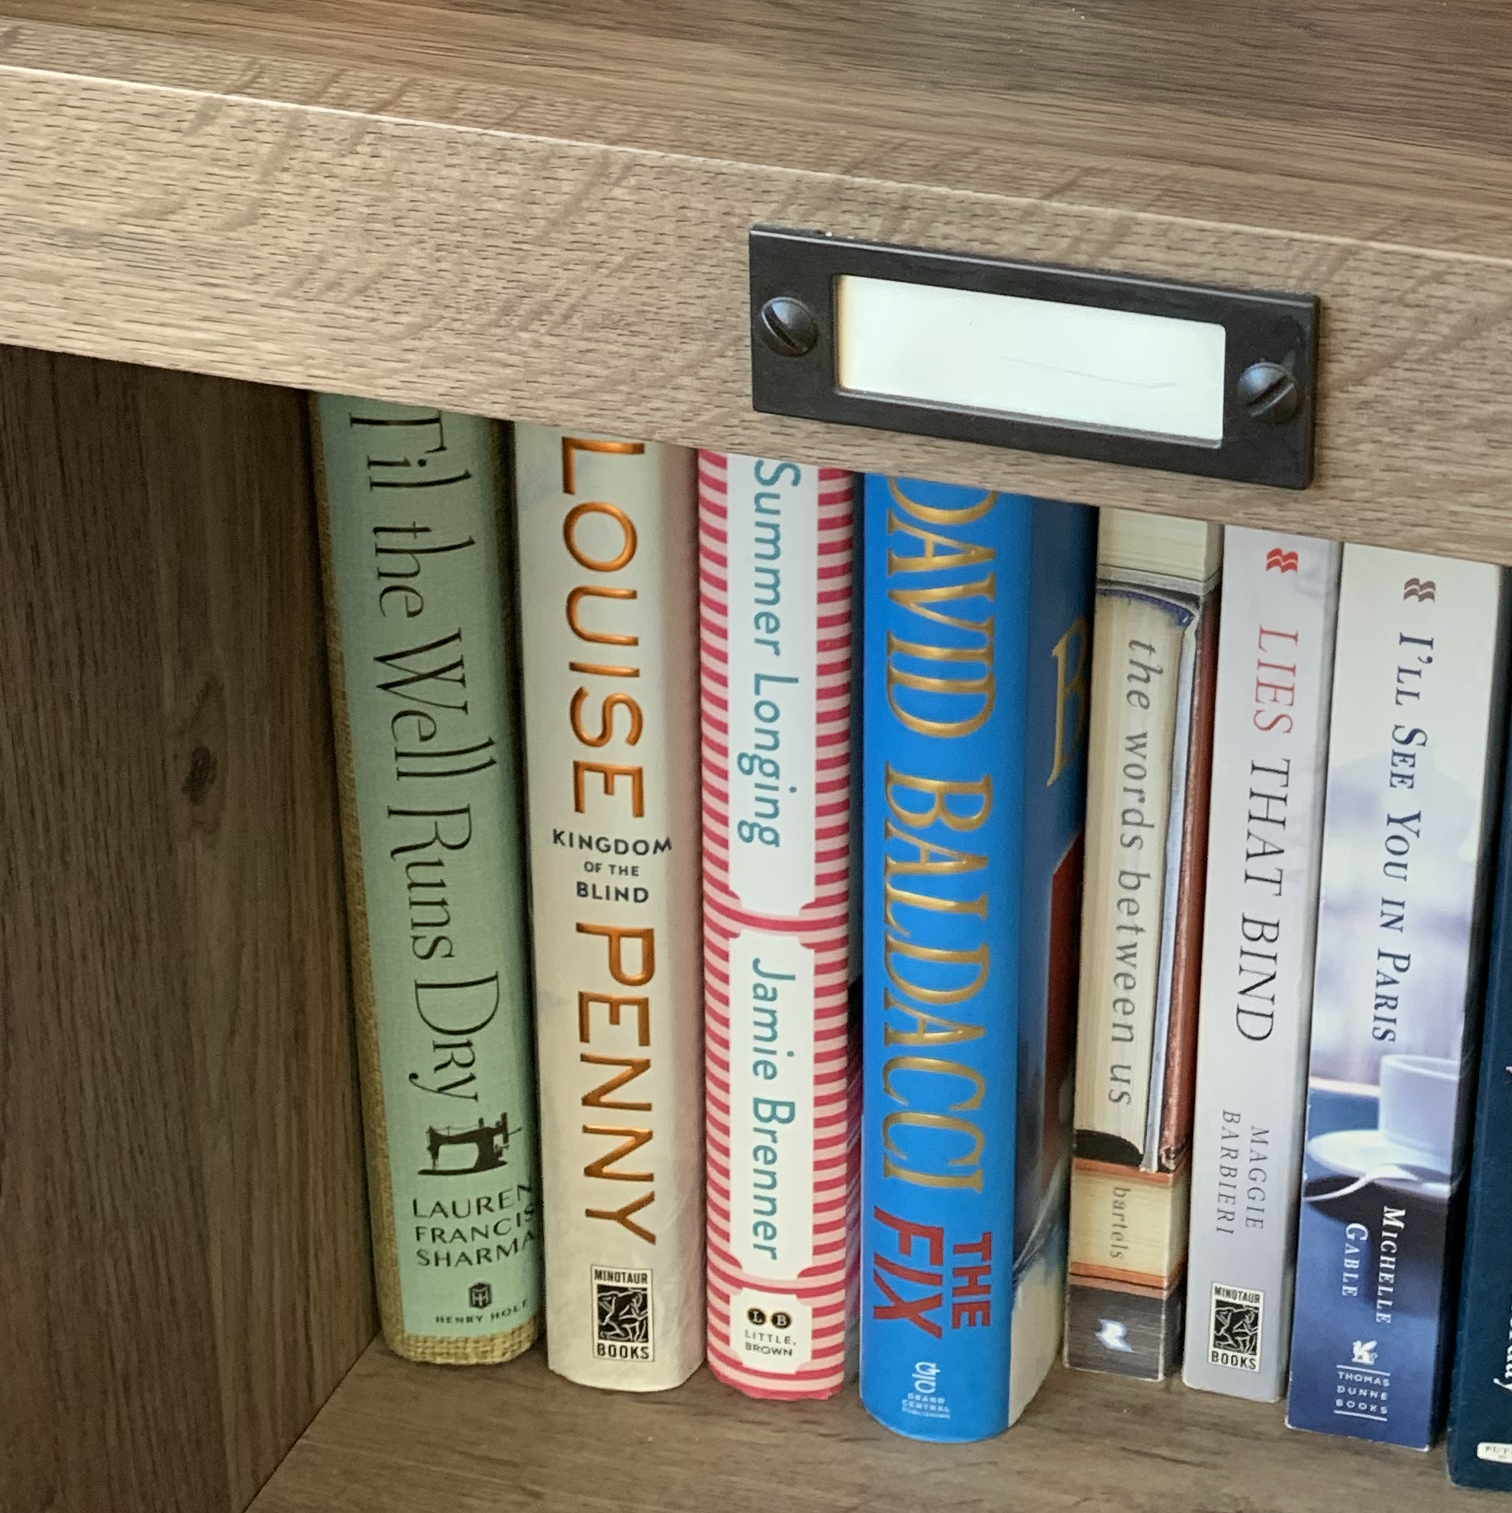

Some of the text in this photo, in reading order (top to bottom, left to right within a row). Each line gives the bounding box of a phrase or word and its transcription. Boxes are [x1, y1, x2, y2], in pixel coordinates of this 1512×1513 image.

[737, 457, 801, 849] Summer Longing
[373, 520, 500, 1102] the Well Runs Dry
[1235, 623, 1299, 1044] LIES THAT BIND
[552, 828, 673, 857] KINGDOM
[561, 436, 656, 1246] LOUISE PENNY
[583, 860, 639, 878] OF THE
[575, 880, 649, 905] BLIND
[1107, 638, 1165, 1106] the words between us
[752, 956, 796, 1262] Jamie Brenner
[413, 1183, 532, 1219] LAUREN
[1216, 1108, 1242, 1236] BARBIERI
[1244, 1125, 1270, 1231] MAGGIE
[415, 1202, 534, 1244] FRANCIS
[416, 1229, 536, 1268] SHARMA
[1110, 1186, 1134, 1261] bartels
[594, 1269, 649, 1286] MINOTAUR
[873, 1206, 944, 1340] FIX
[951, 1231, 993, 1330] THE
[596, 1343, 650, 1360] BOOKS
[1337, 1370, 1391, 1387] THOMAS
[1335, 1398, 1389, 1415] BOOKS
[1336, 1384, 1389, 1401] DUNNE
